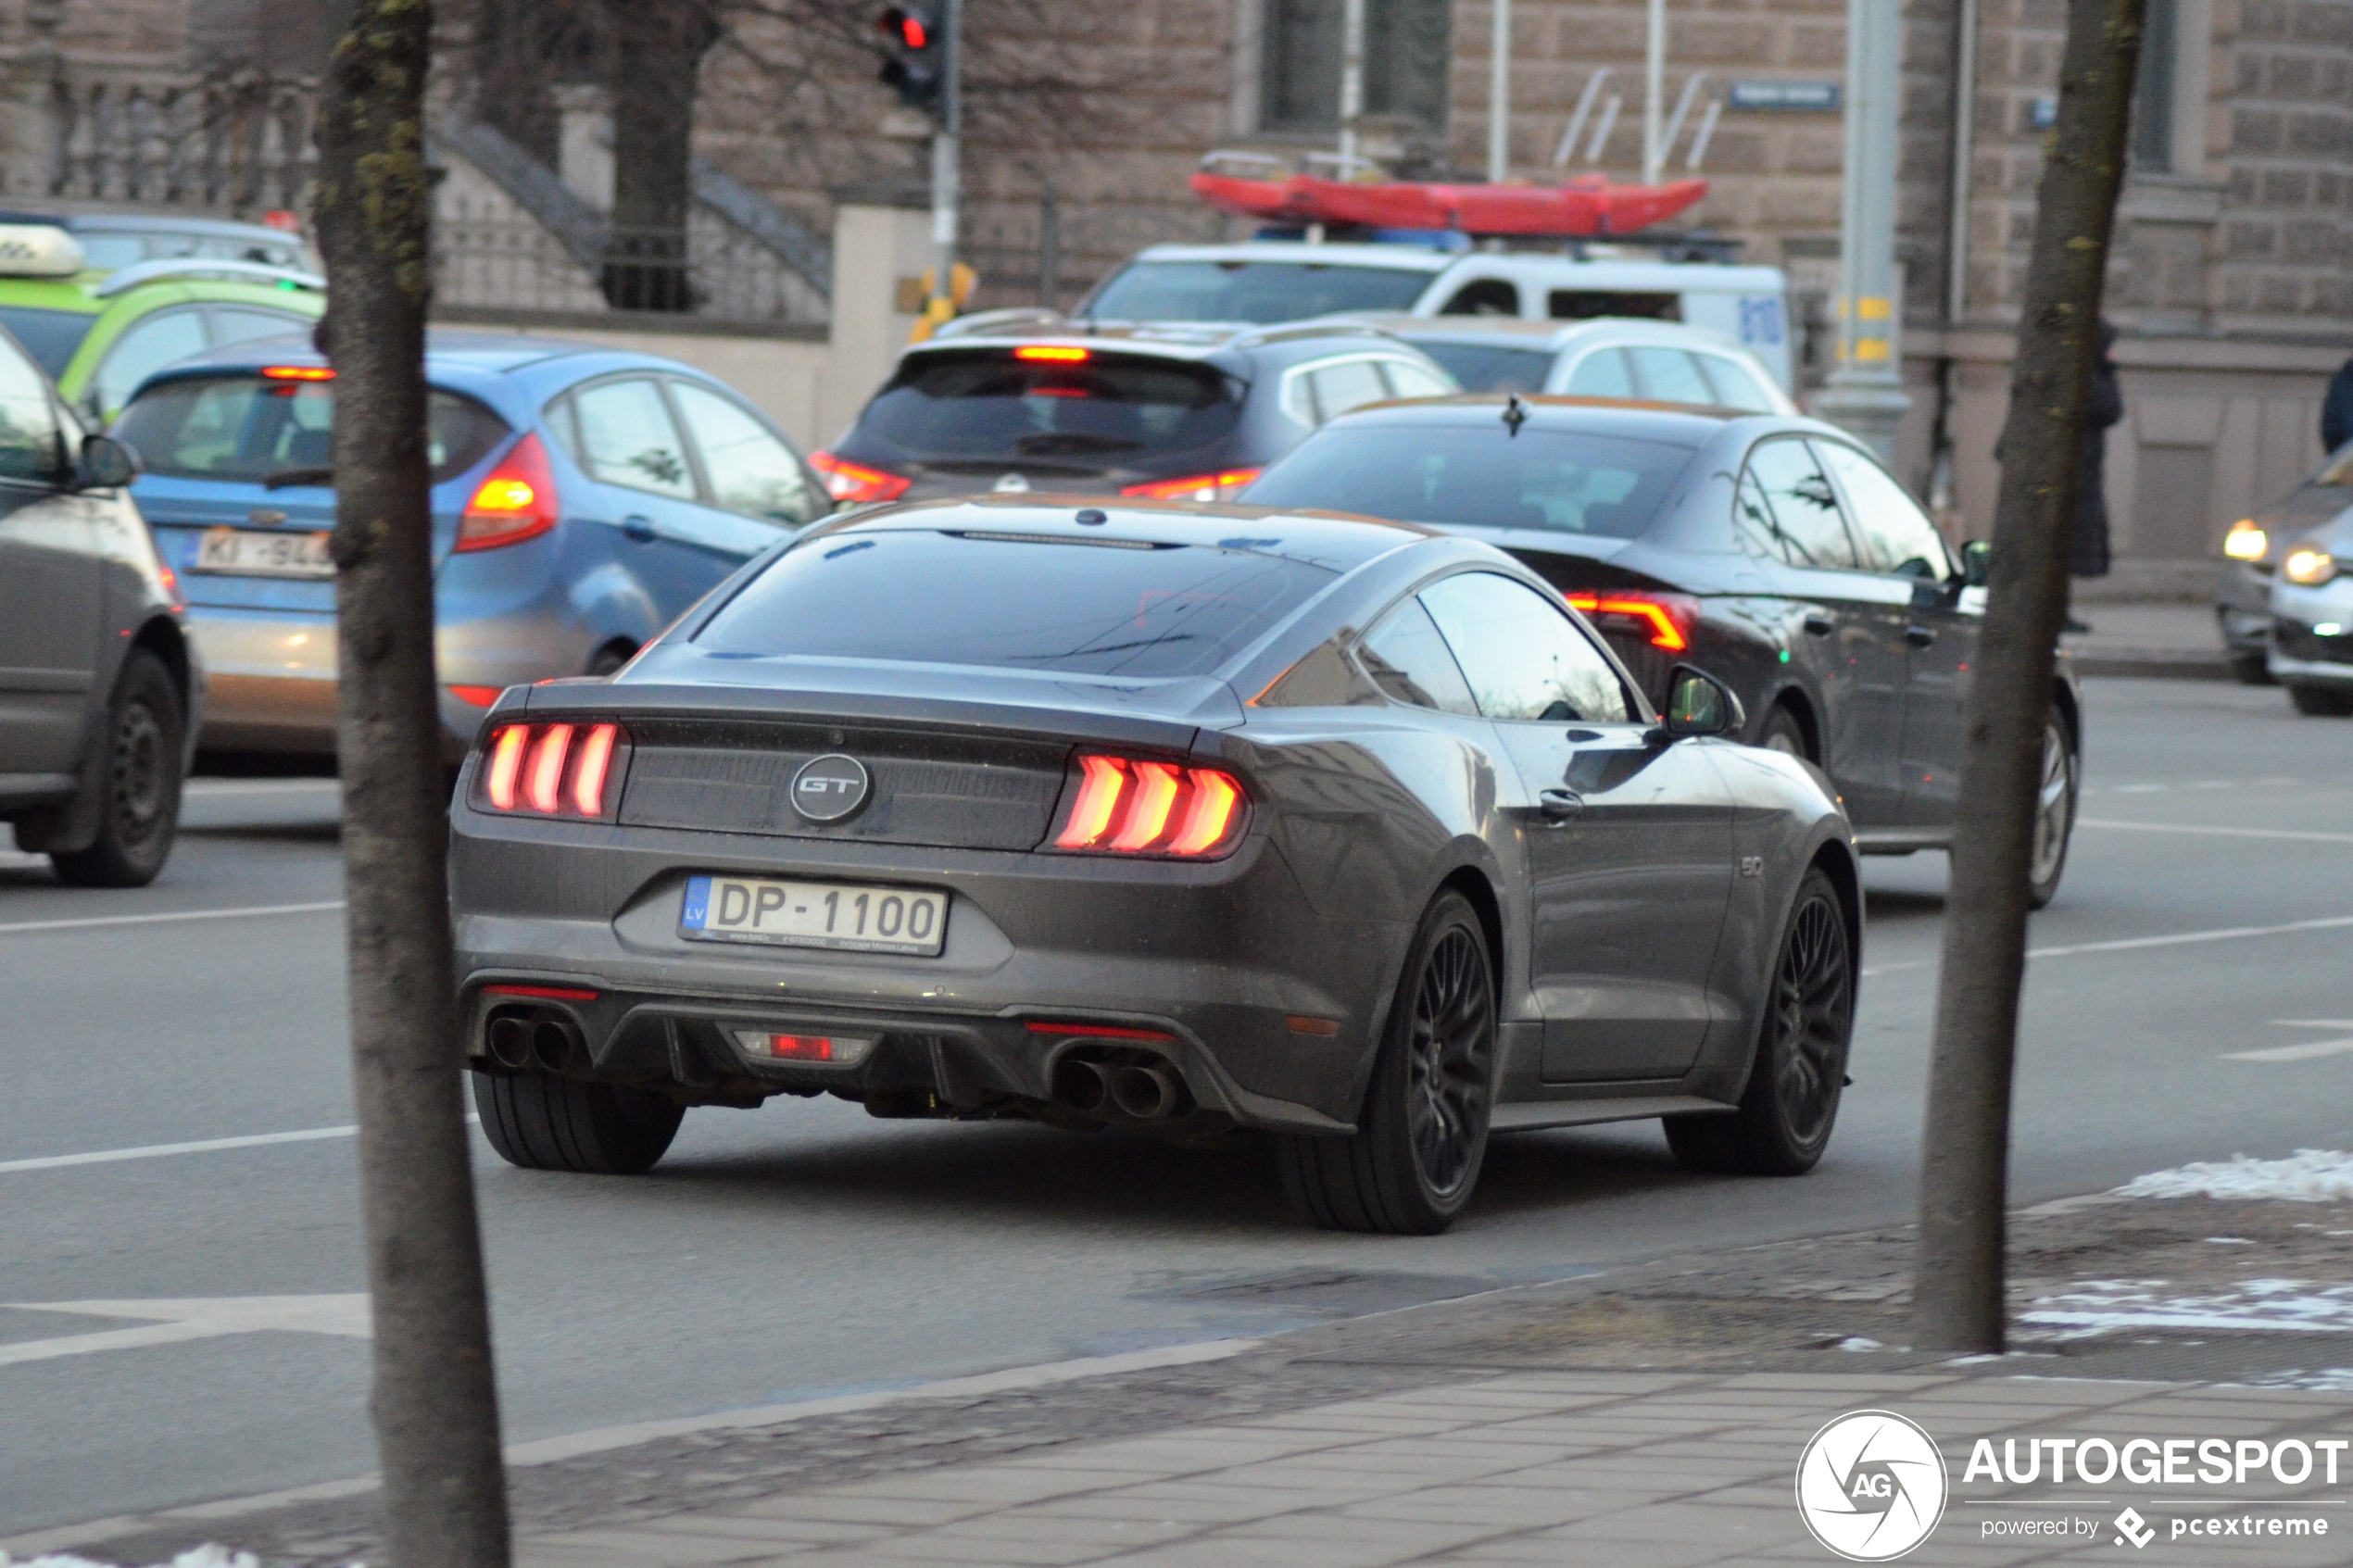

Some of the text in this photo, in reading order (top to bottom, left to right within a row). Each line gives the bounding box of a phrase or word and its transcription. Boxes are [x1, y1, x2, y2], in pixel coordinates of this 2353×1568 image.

[799, 777, 860, 794] GT
[686, 908, 705, 922] LV
[717, 883, 935, 940] DP-1100
